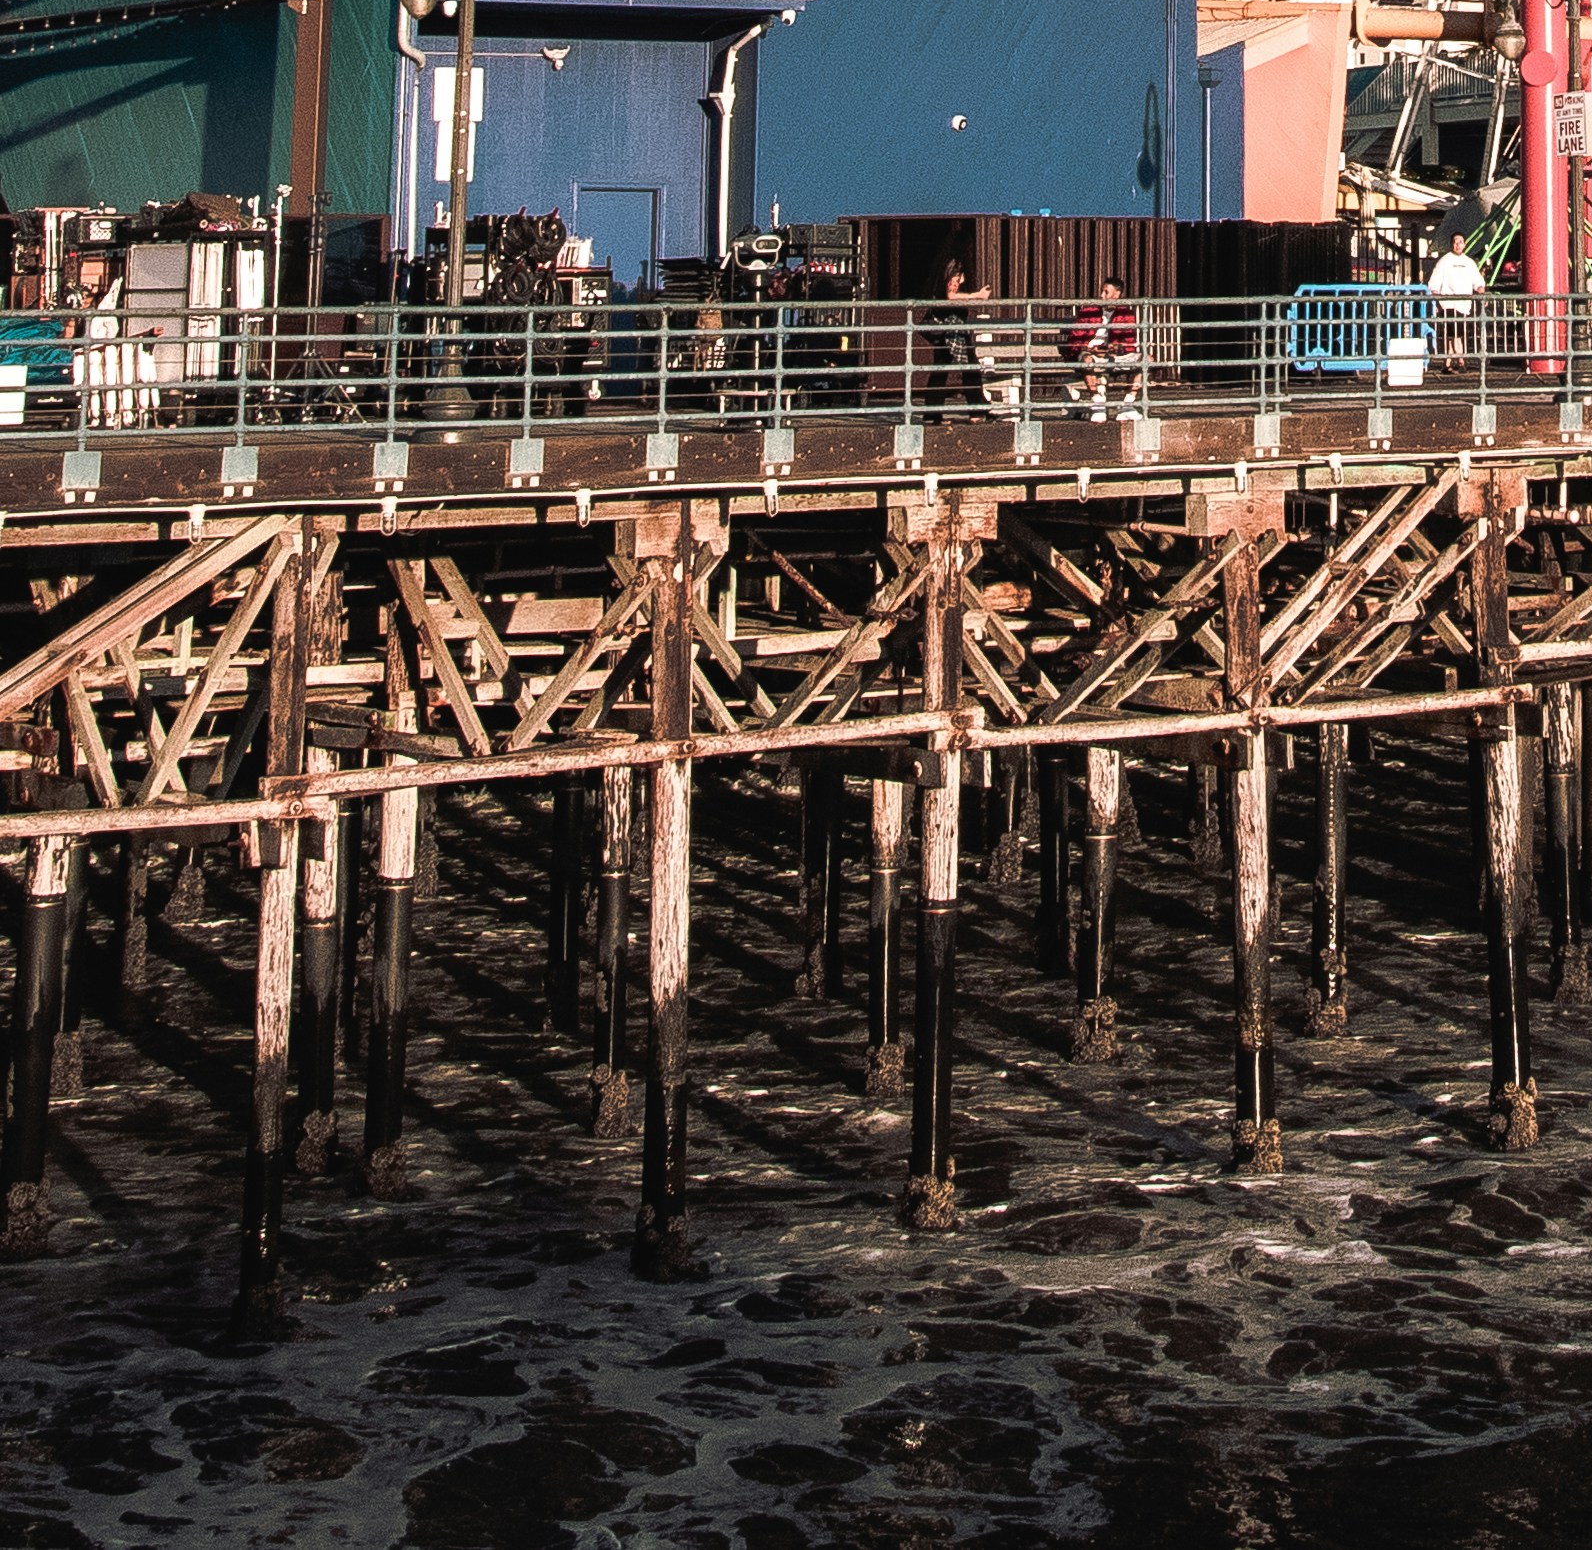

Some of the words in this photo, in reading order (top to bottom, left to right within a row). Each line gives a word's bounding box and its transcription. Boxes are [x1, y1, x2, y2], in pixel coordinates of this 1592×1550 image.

[1572, 107, 1583, 115] TIME
[1559, 120, 1581, 137] FIRE
[1558, 136, 1584, 153] LANE
